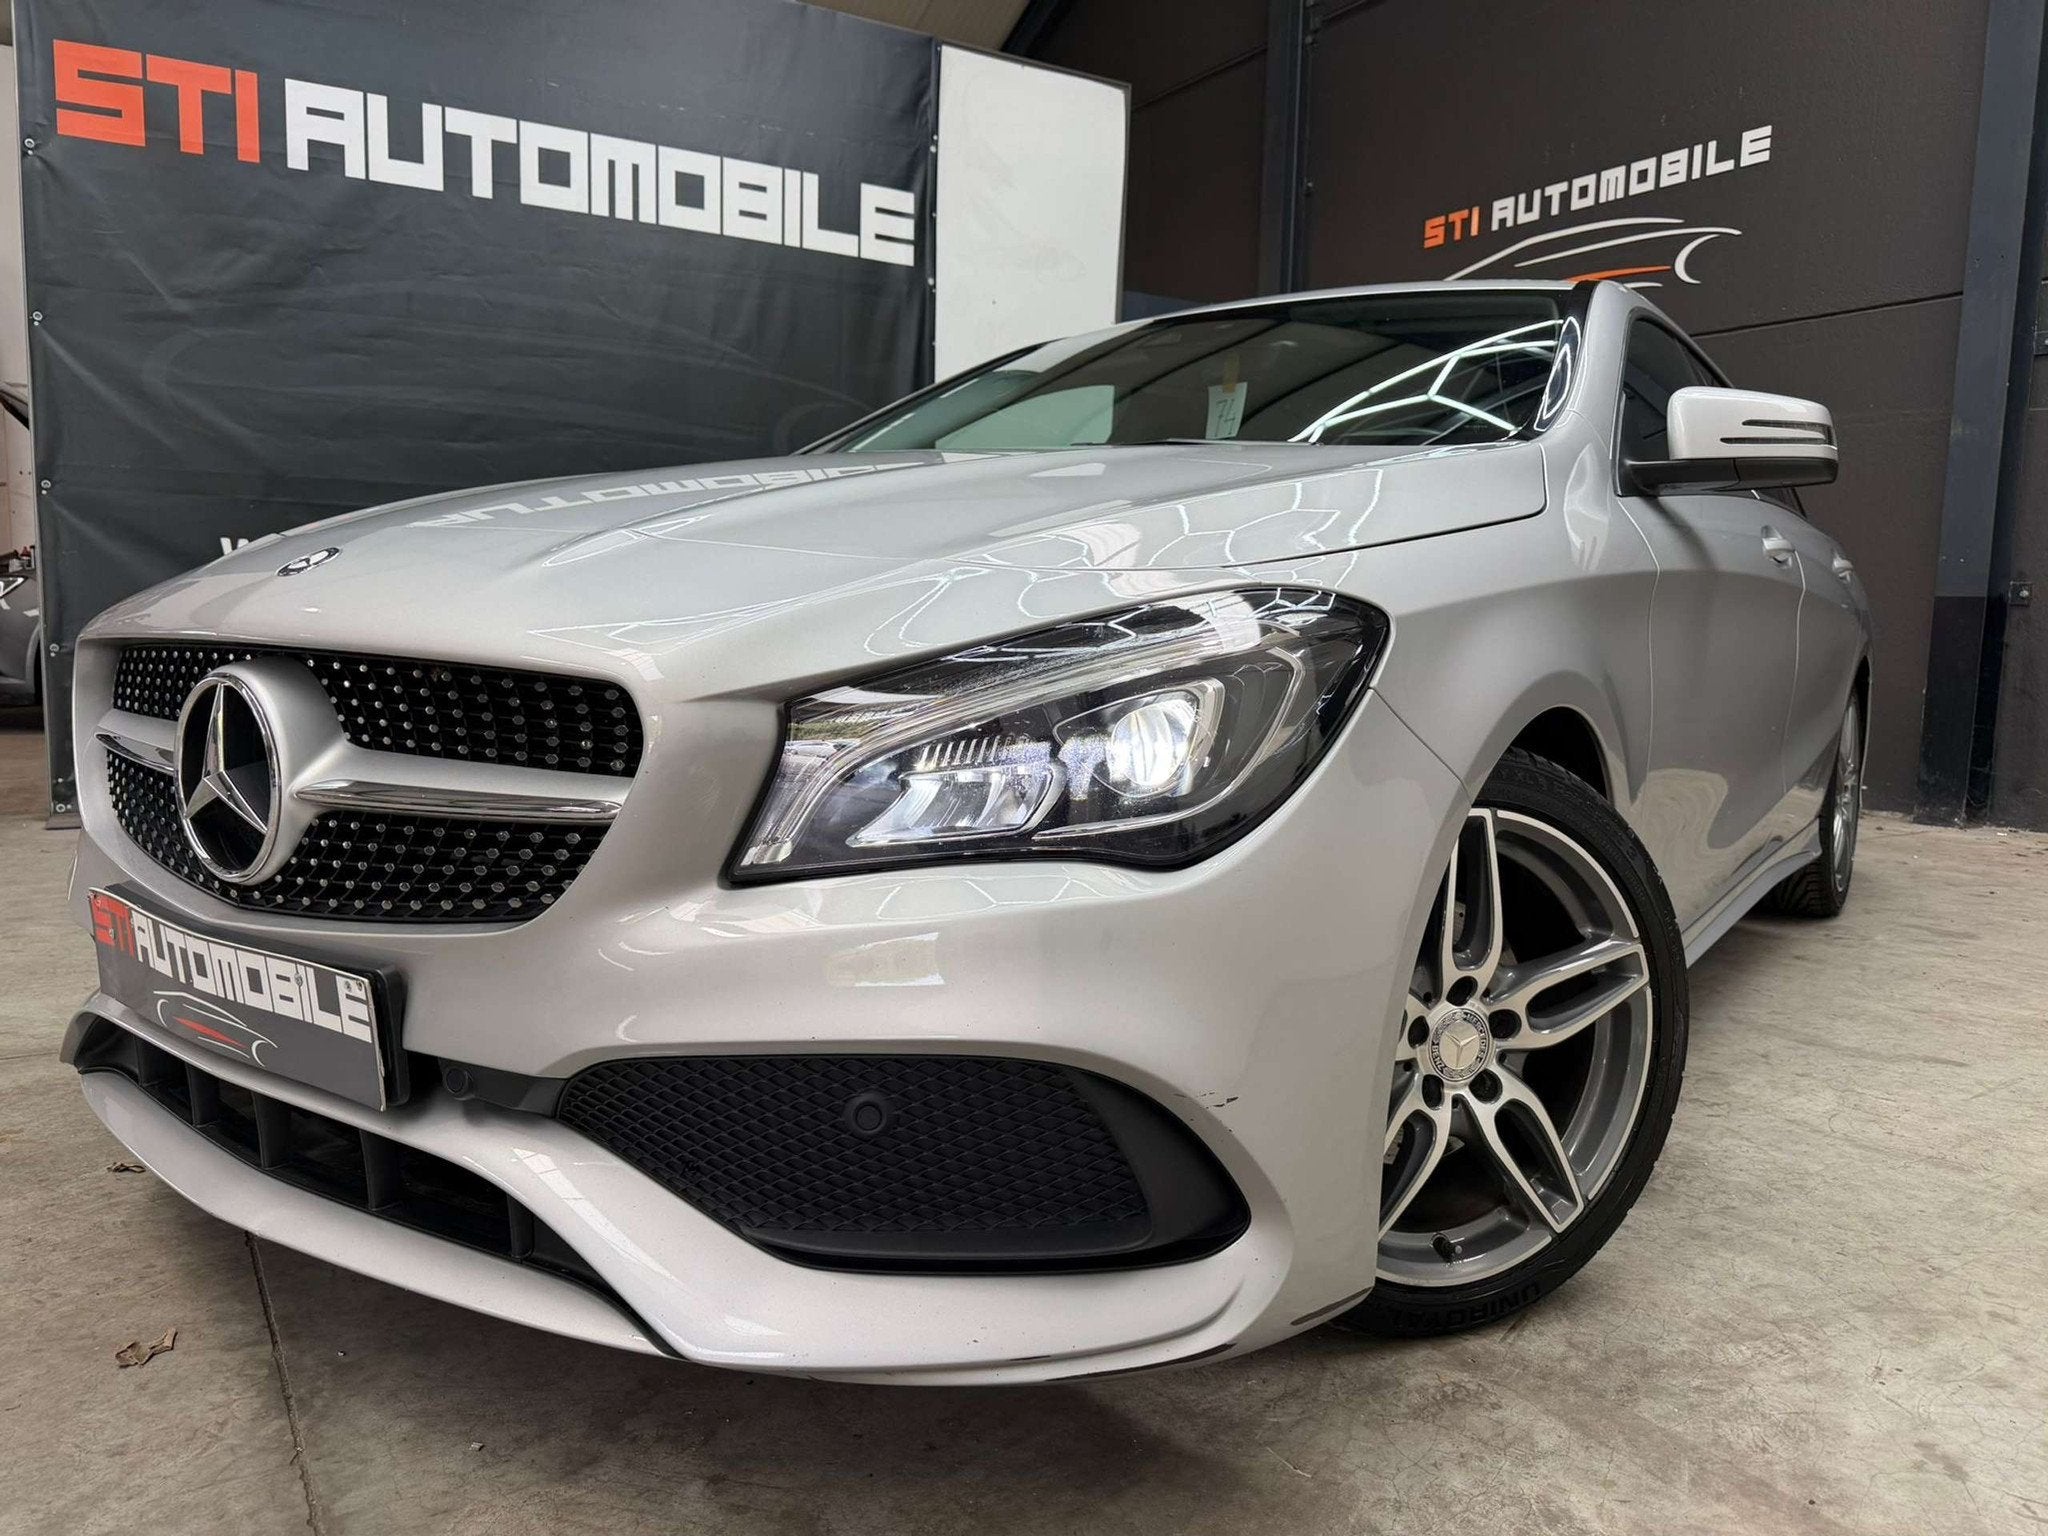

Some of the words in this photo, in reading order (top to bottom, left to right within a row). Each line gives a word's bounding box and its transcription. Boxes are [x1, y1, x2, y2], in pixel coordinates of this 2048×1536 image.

[53, 39, 260, 163] STI
[285, 78, 916, 266] AUTOMOBILE
[1423, 206, 1480, 249] STI
[1490, 124, 1773, 231] AUTOMOBILE
[92, 892, 135, 959] STI
[131, 909, 373, 1044] AUTOMOBILE
